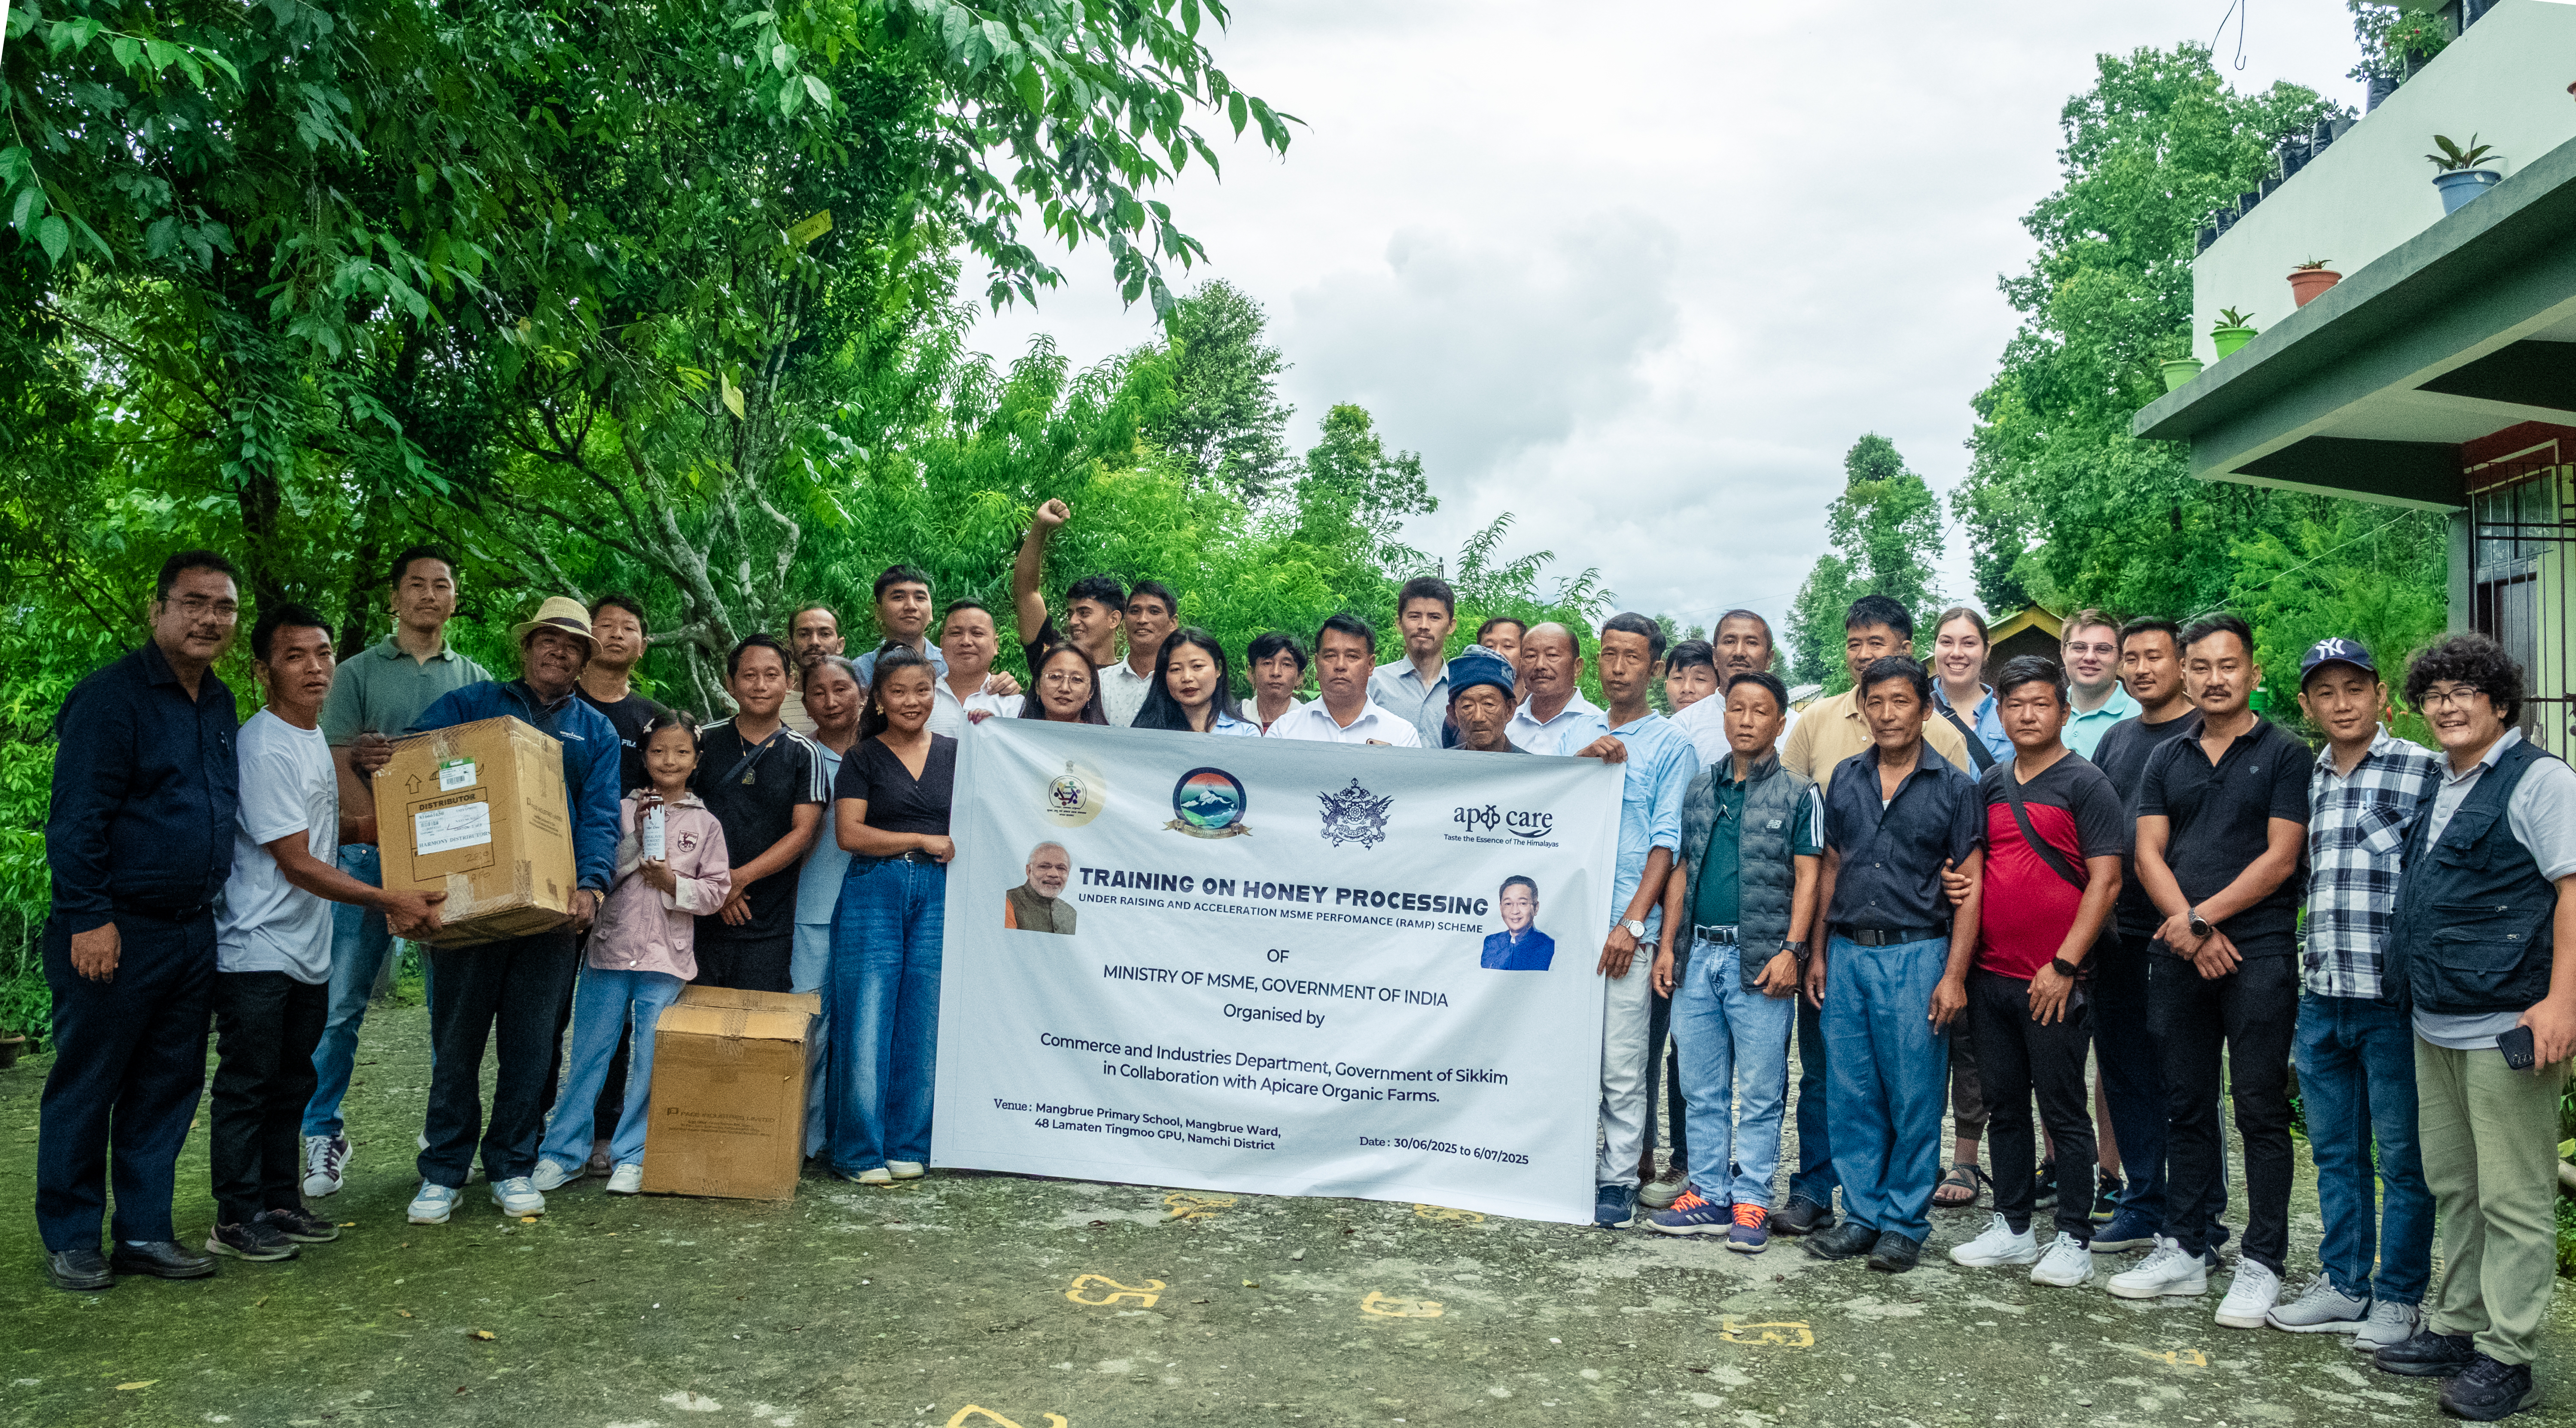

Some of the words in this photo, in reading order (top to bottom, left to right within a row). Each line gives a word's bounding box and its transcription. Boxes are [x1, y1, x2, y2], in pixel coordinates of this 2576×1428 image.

[419, 794, 475, 810] DISTRIBUTOR
[419, 839, 447, 848] HARMONY
[1527, 840, 1559, 848] Himalayas
[1080, 868, 1194, 892] TRAINING
[1203, 878, 1235, 896] ON
[1243, 881, 1328, 903] HONEY
[1336, 888, 1488, 916] PROCESSING
[1079, 893, 1117, 904] UNDER
[1121, 897, 1164, 907] RAISING
[1167, 901, 1191, 909] AND
[1194, 903, 1277, 917] ACCELERATION
[1280, 910, 1313, 920] MSME
[1317, 912, 1393, 926] PERFOMANCE
[1396, 918, 1434, 930] (RAMP)
[1438, 922, 1483, 933] SCHEME
[1267, 949, 1289, 963] OF
[1104, 965, 1178, 983] MINISTRY
[1181, 971, 1203, 985] OF
[1207, 973, 1258, 993] MSME,
[1262, 978, 1376, 1000] GOVERNMENT
[1379, 988, 1401, 1002] OF
[1405, 990, 1448, 1007] INDIA
[1224, 1004, 1302, 1023] Organised
[1306, 1010, 1325, 1028] by
[1041, 1032, 1121, 1054] Commerce
[1125, 1044, 1152, 1058] and
[1157, 1046, 1231, 1065] Industries
[1236, 1052, 1331, 1077] Department,
[1335, 1062, 1433, 1081] Government
[1437, 1069, 1453, 1081] of
[1456, 1069, 1507, 1085] Sikkim
[1104, 1061, 1116, 1075] in
[1121, 1064, 1218, 1086] Collaboration
[1223, 1074, 1256, 1090] with
[1260, 1078, 1318, 1095] Apicare
[1322, 1084, 1383, 1102] Organic
[1388, 1089, 1439, 1102] Farms.
[1035, 1118, 1049, 1128] 48
[1053, 1119, 1102, 1133] Lamaten
[1105, 1124, 1154, 1137] Tingmoo
[1157, 1130, 1184, 1142] GPU,
[1188, 1133, 1230, 1146] Namchi
[1234, 1138, 1275, 1150] District
[1036, 1103, 1093, 1117] Mangbrue
[1097, 1108, 1140, 1123] Primary
[1143, 1113, 1182, 1128] School,
[1186, 1119, 1243, 1133] Mangbrue
[1247, 1125, 1281, 1139] Ward,
[1394, 1138, 1457, 1154] 30/06/2025
[1460, 1146, 1471, 1156] to
[1474, 1147, 1529, 1164] 6/07/2025
